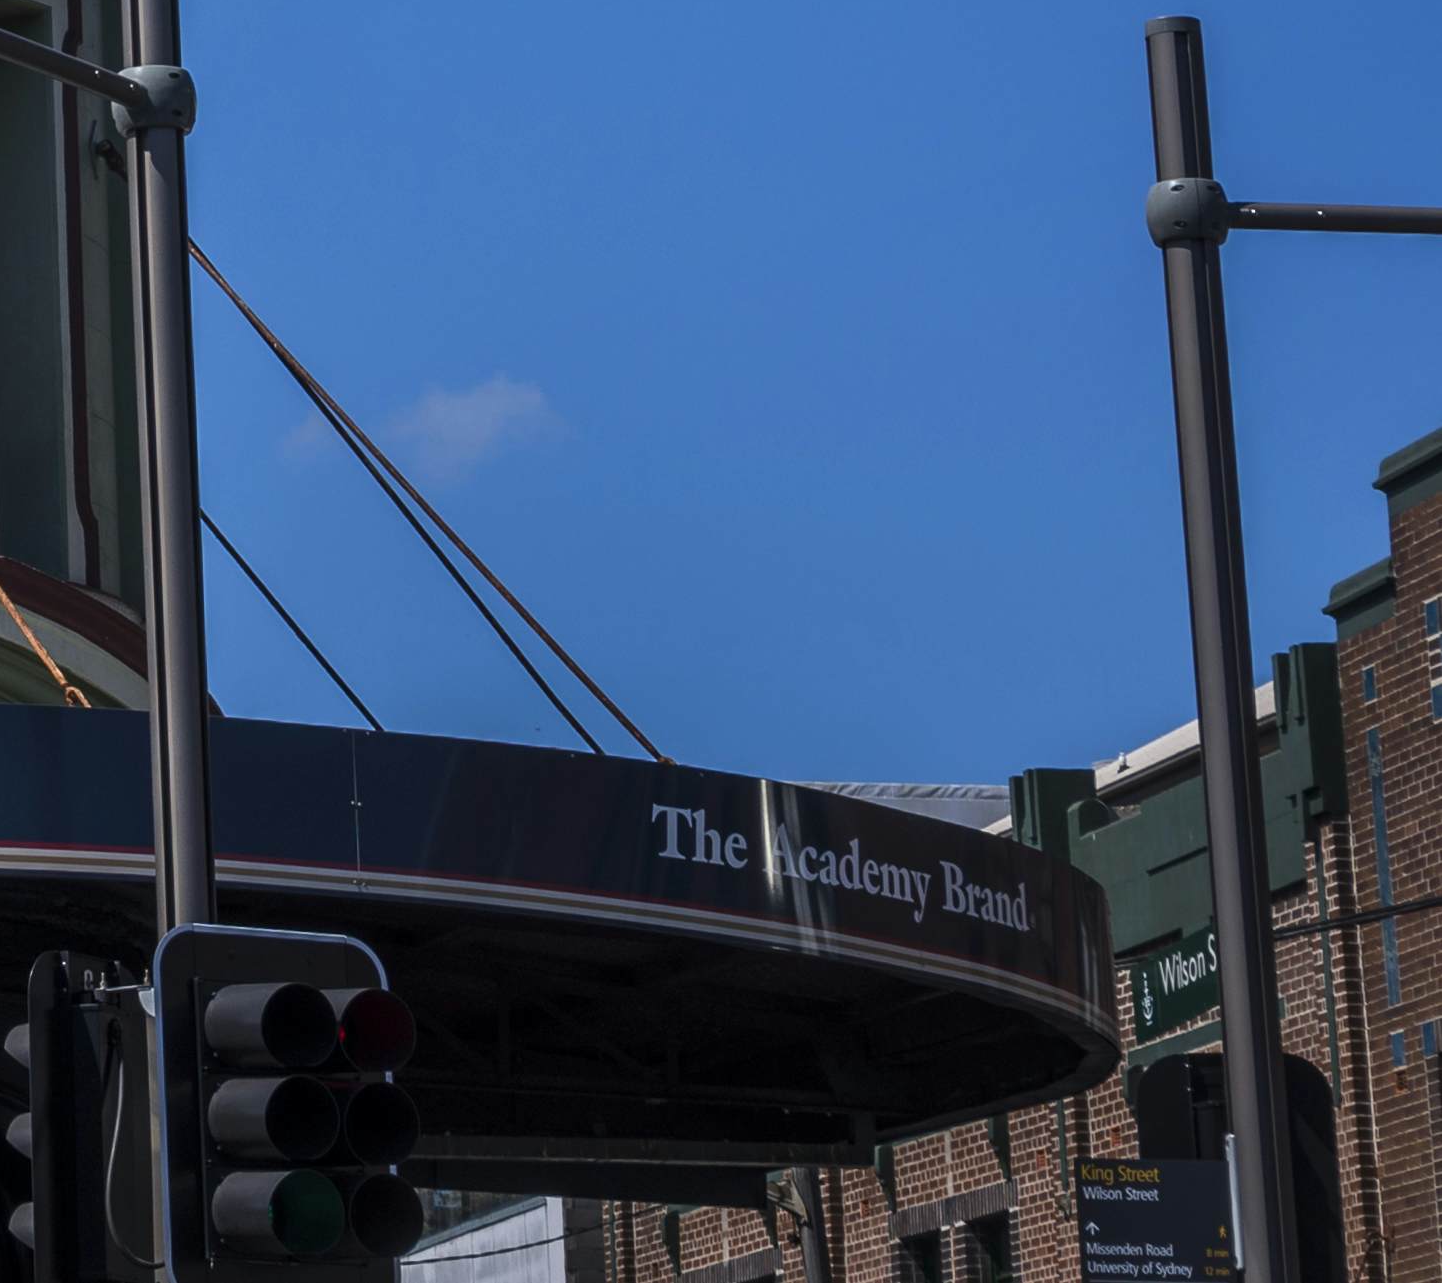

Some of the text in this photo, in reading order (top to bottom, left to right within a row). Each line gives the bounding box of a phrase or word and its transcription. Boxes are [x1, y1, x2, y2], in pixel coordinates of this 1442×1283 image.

[651, 803, 748, 869] The
[763, 823, 930, 922] Academy
[1159, 951, 1206, 996] Wilson
[1081, 1164, 1160, 1185] King Street
[1082, 1186, 1159, 1201] Wilson Street
[1086, 1242, 1174, 1257] Missenden Road
[1087, 1260, 1193, 1278] University of Sydney
